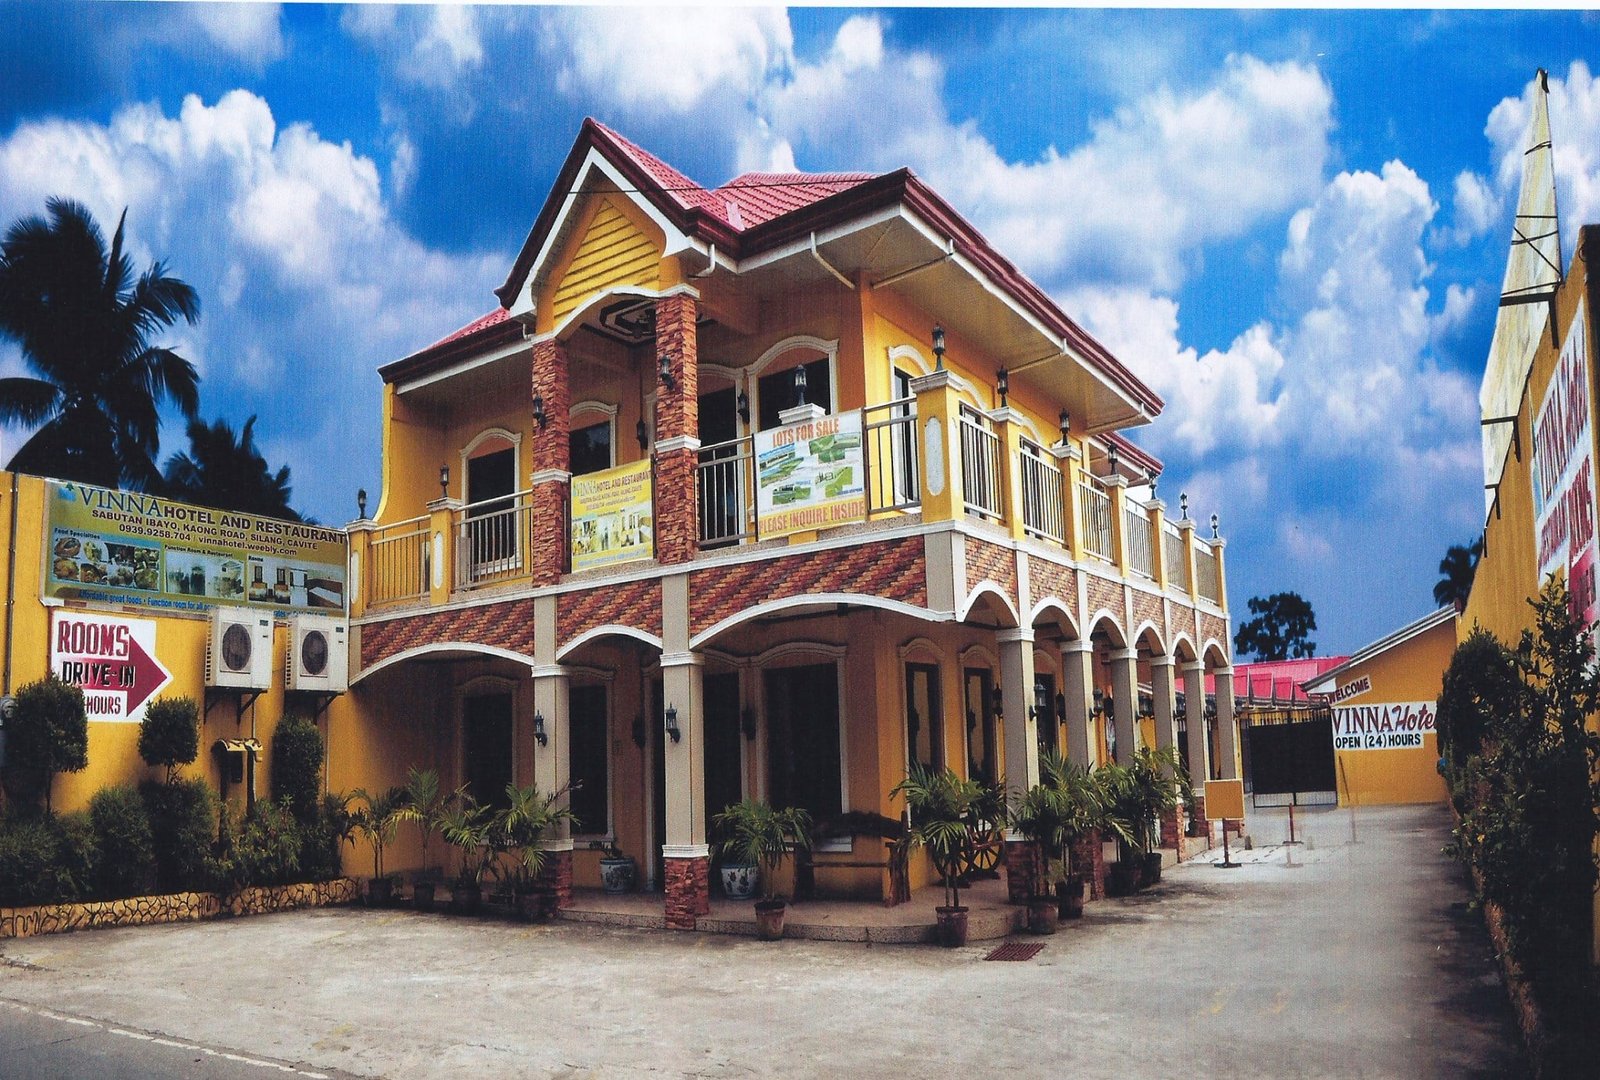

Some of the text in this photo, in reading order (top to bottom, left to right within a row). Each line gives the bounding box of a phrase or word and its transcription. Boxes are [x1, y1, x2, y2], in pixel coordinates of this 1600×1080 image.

[772, 418, 839, 448] LOTS FOR SALE
[79, 486, 346, 544] VINNA HOTEL AND RESTAURANT
[92, 509, 318, 550] SABUTAN IBAYO, KAONG ROAD, SILANG, CAVITE
[759, 500, 864, 534] PLEASE INQUIRE INSIDE
[119, 523, 297, 556] 0939.9258.704 vinnahotel.weebly.com
[57, 620, 130, 657] ROOMS
[62, 661, 136, 688] DRIVE-IN
[1327, 677, 1370, 705] WELCOME
[1331, 703, 1437, 735] VINNA Hote
[1335, 733, 1421, 749] OPEN (24) HOURS
